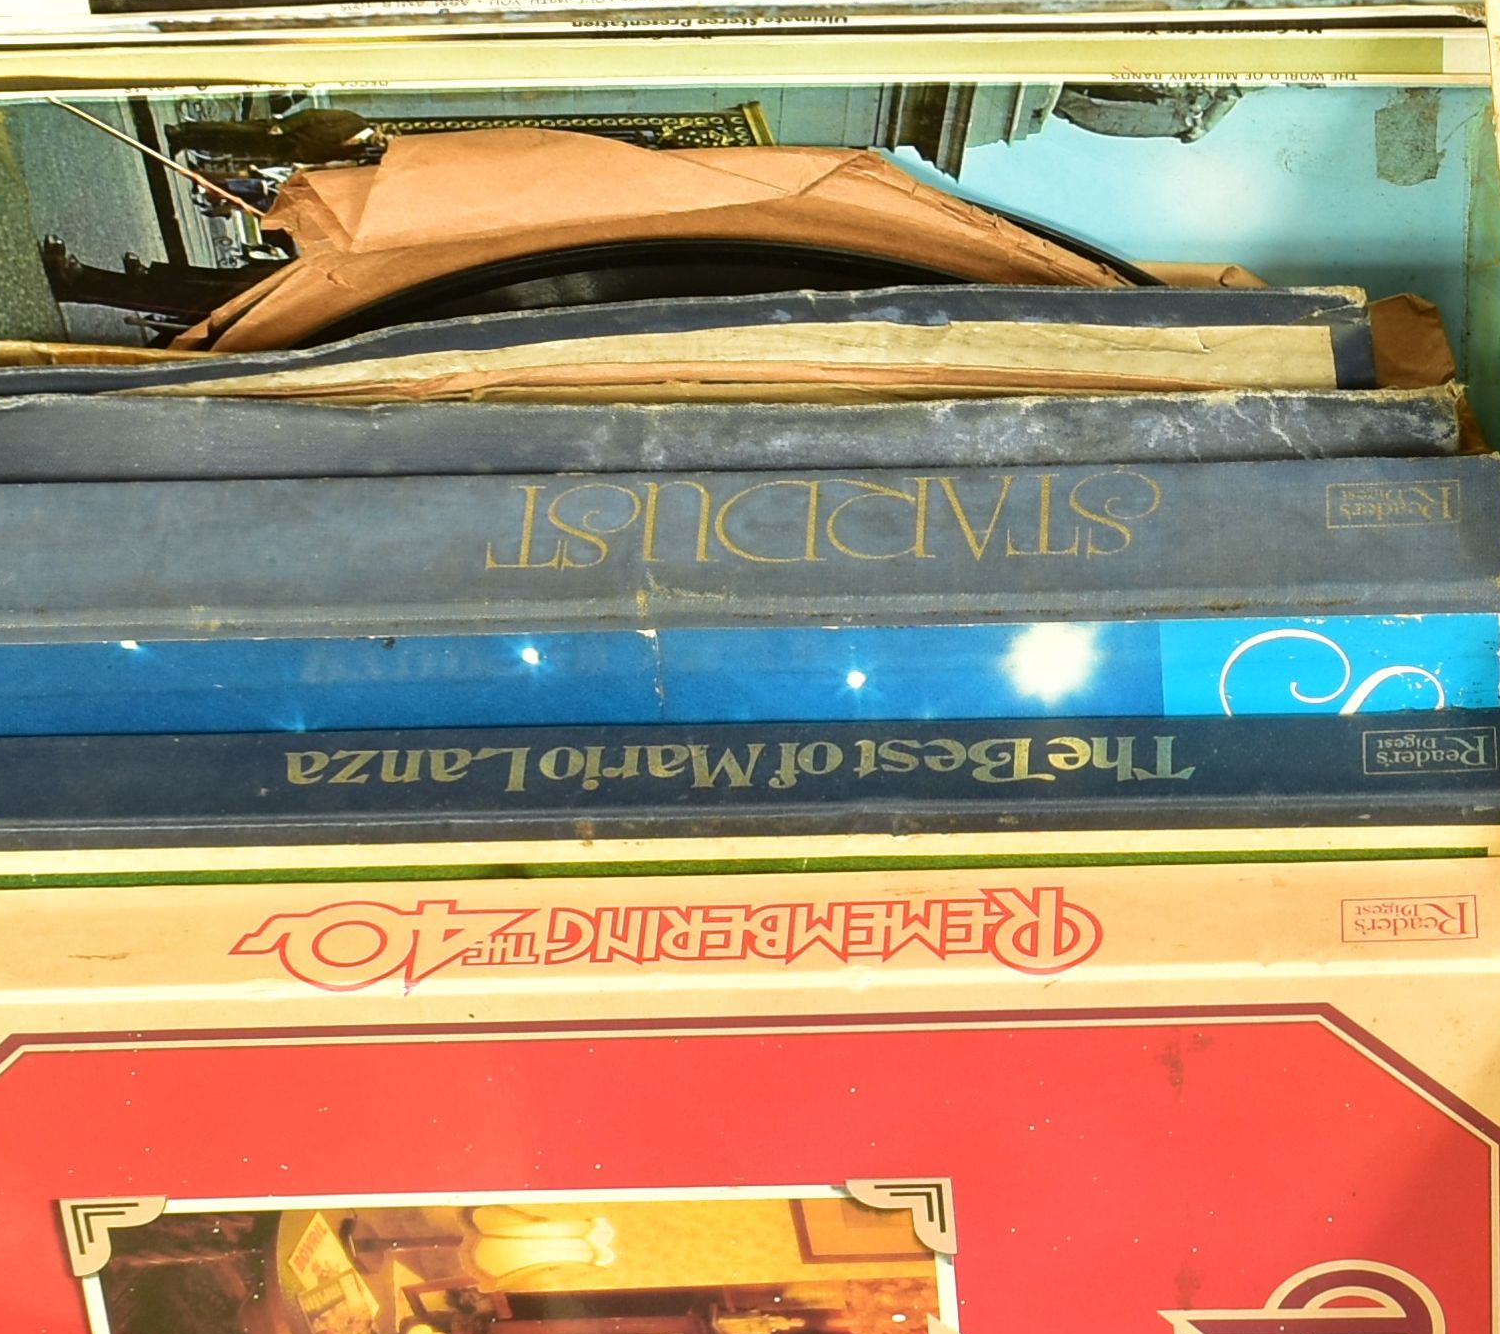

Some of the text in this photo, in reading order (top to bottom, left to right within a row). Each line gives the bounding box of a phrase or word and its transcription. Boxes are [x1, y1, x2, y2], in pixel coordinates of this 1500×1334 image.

[486, 470, 1161, 571] STARDUST
[284, 734, 1195, 793] The Best of Mario Lanza
[1376, 734, 1487, 769] Reader's Digest
[544, 886, 1103, 976] REMEMBERING
[1352, 901, 1470, 939] Reader's Digest
[464, 930, 541, 968] THE
